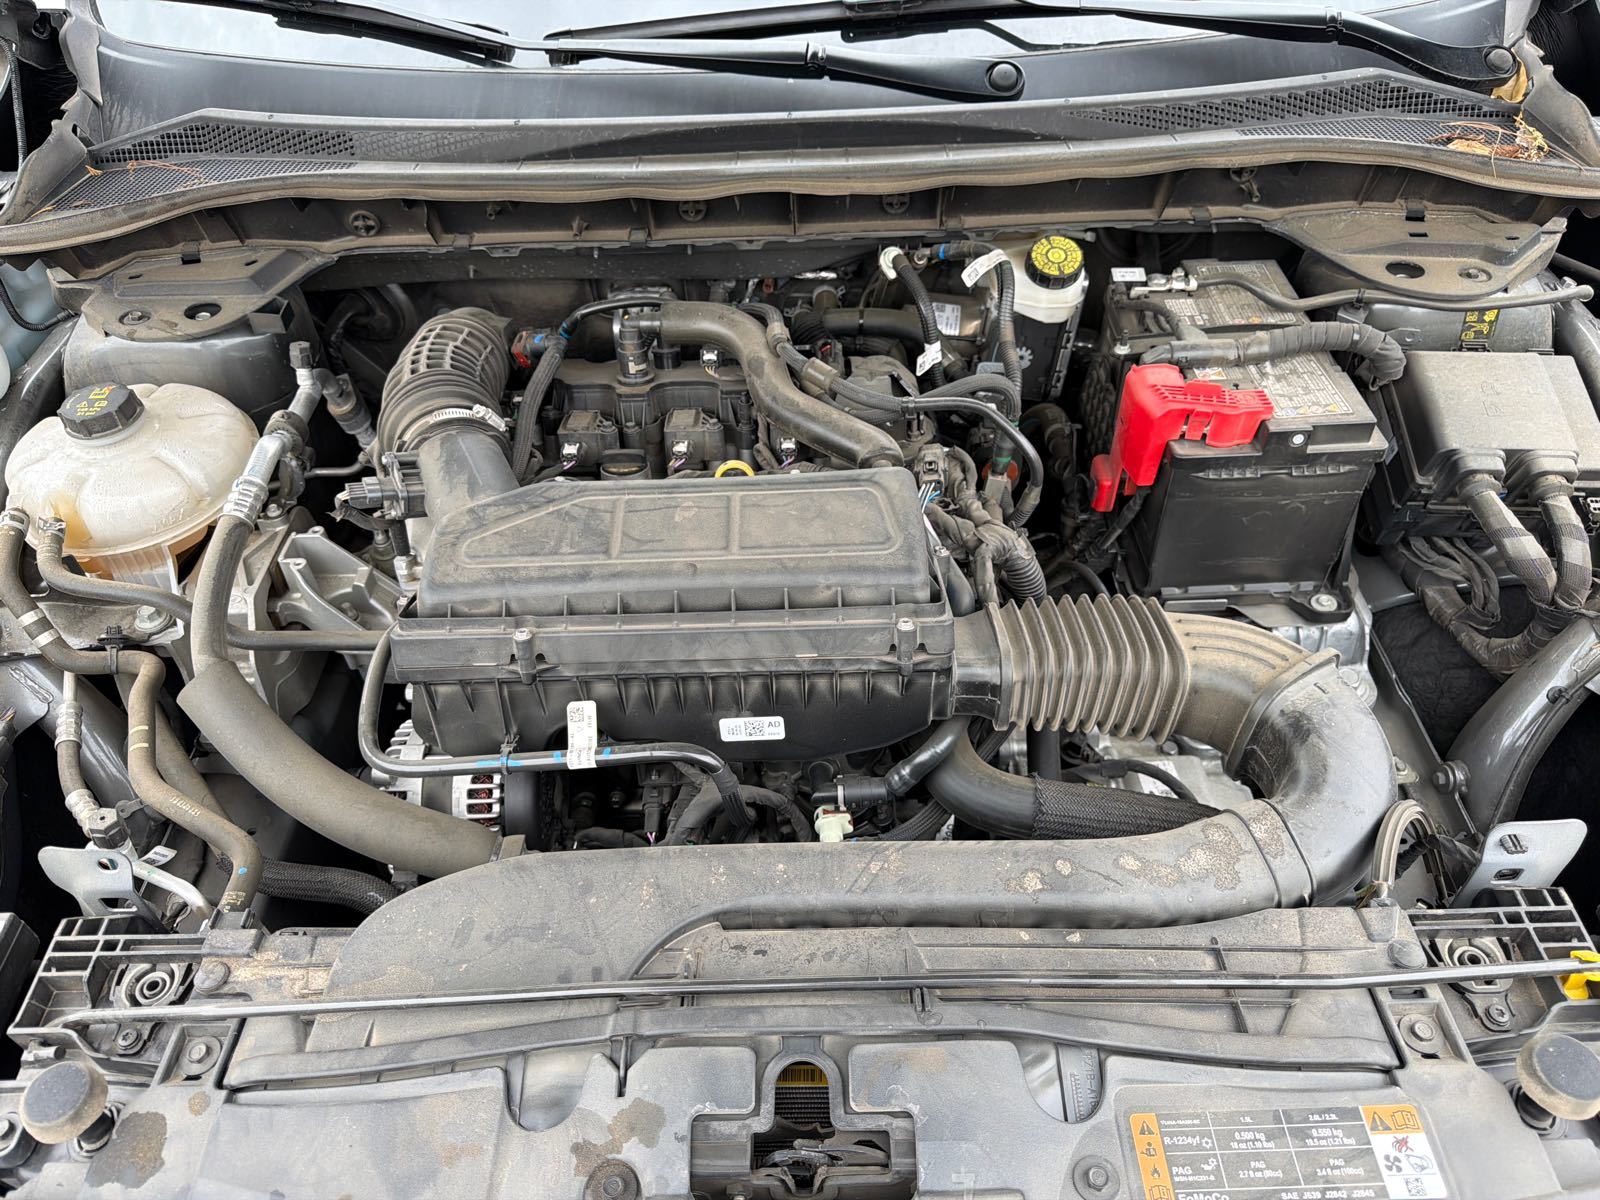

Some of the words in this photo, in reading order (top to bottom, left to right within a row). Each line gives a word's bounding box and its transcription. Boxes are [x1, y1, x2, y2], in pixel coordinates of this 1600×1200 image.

[767, 720, 781, 728] AD
[1234, 1131, 1254, 1140] 0.500
[1255, 1131, 1266, 1141] kg
[1311, 1128, 1332, 1137] 0.550
[1332, 1127, 1343, 1137] kg
[1164, 1135, 1200, 1146] R-1234yf
[1250, 1160, 1266, 1169] PAG
[1329, 1158, 1345, 1166] PAG
[1172, 1166, 1193, 1175] PAG
[1281, 1191, 1300, 1200] SAE
